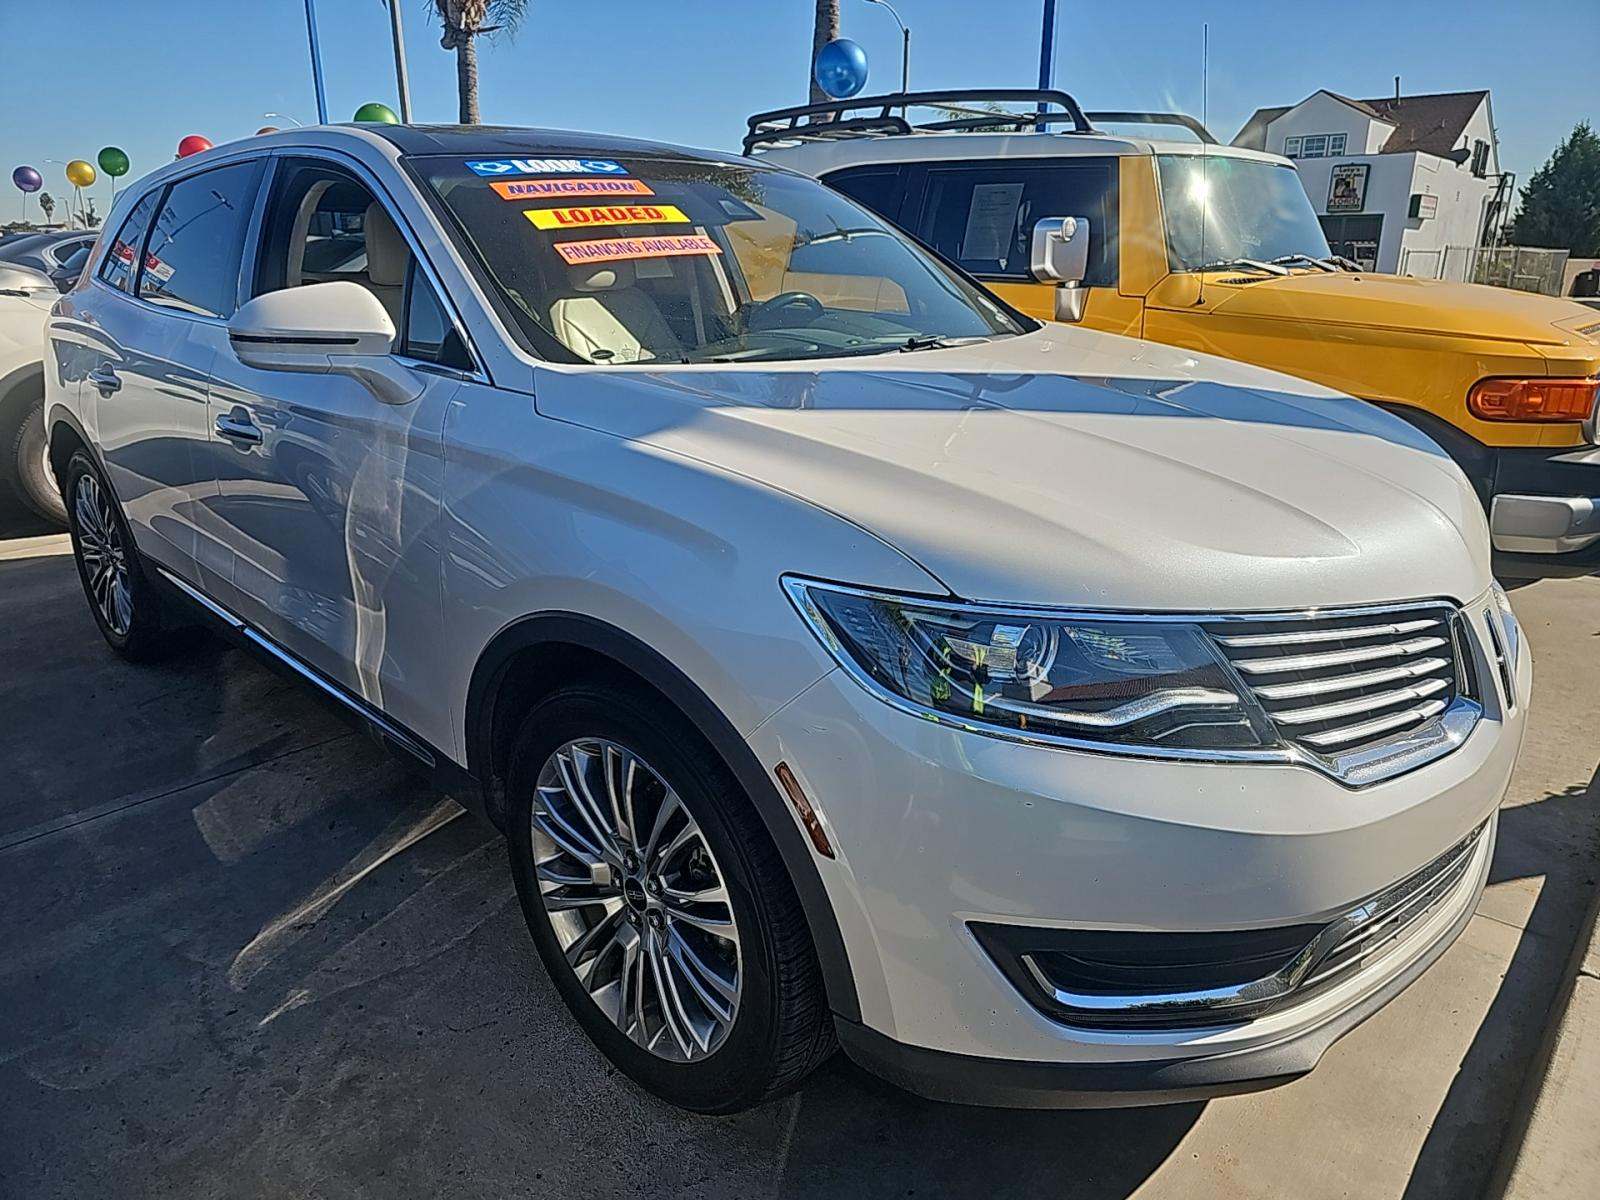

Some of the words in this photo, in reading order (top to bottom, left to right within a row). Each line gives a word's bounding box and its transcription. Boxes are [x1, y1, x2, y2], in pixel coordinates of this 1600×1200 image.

[511, 159, 589, 174] LOOK
[507, 182, 636, 195] NAVIGATION
[552, 206, 667, 225] LOADED
[561, 240, 642, 259] FINANCING
[643, 237, 716, 254] AVAILABLE
